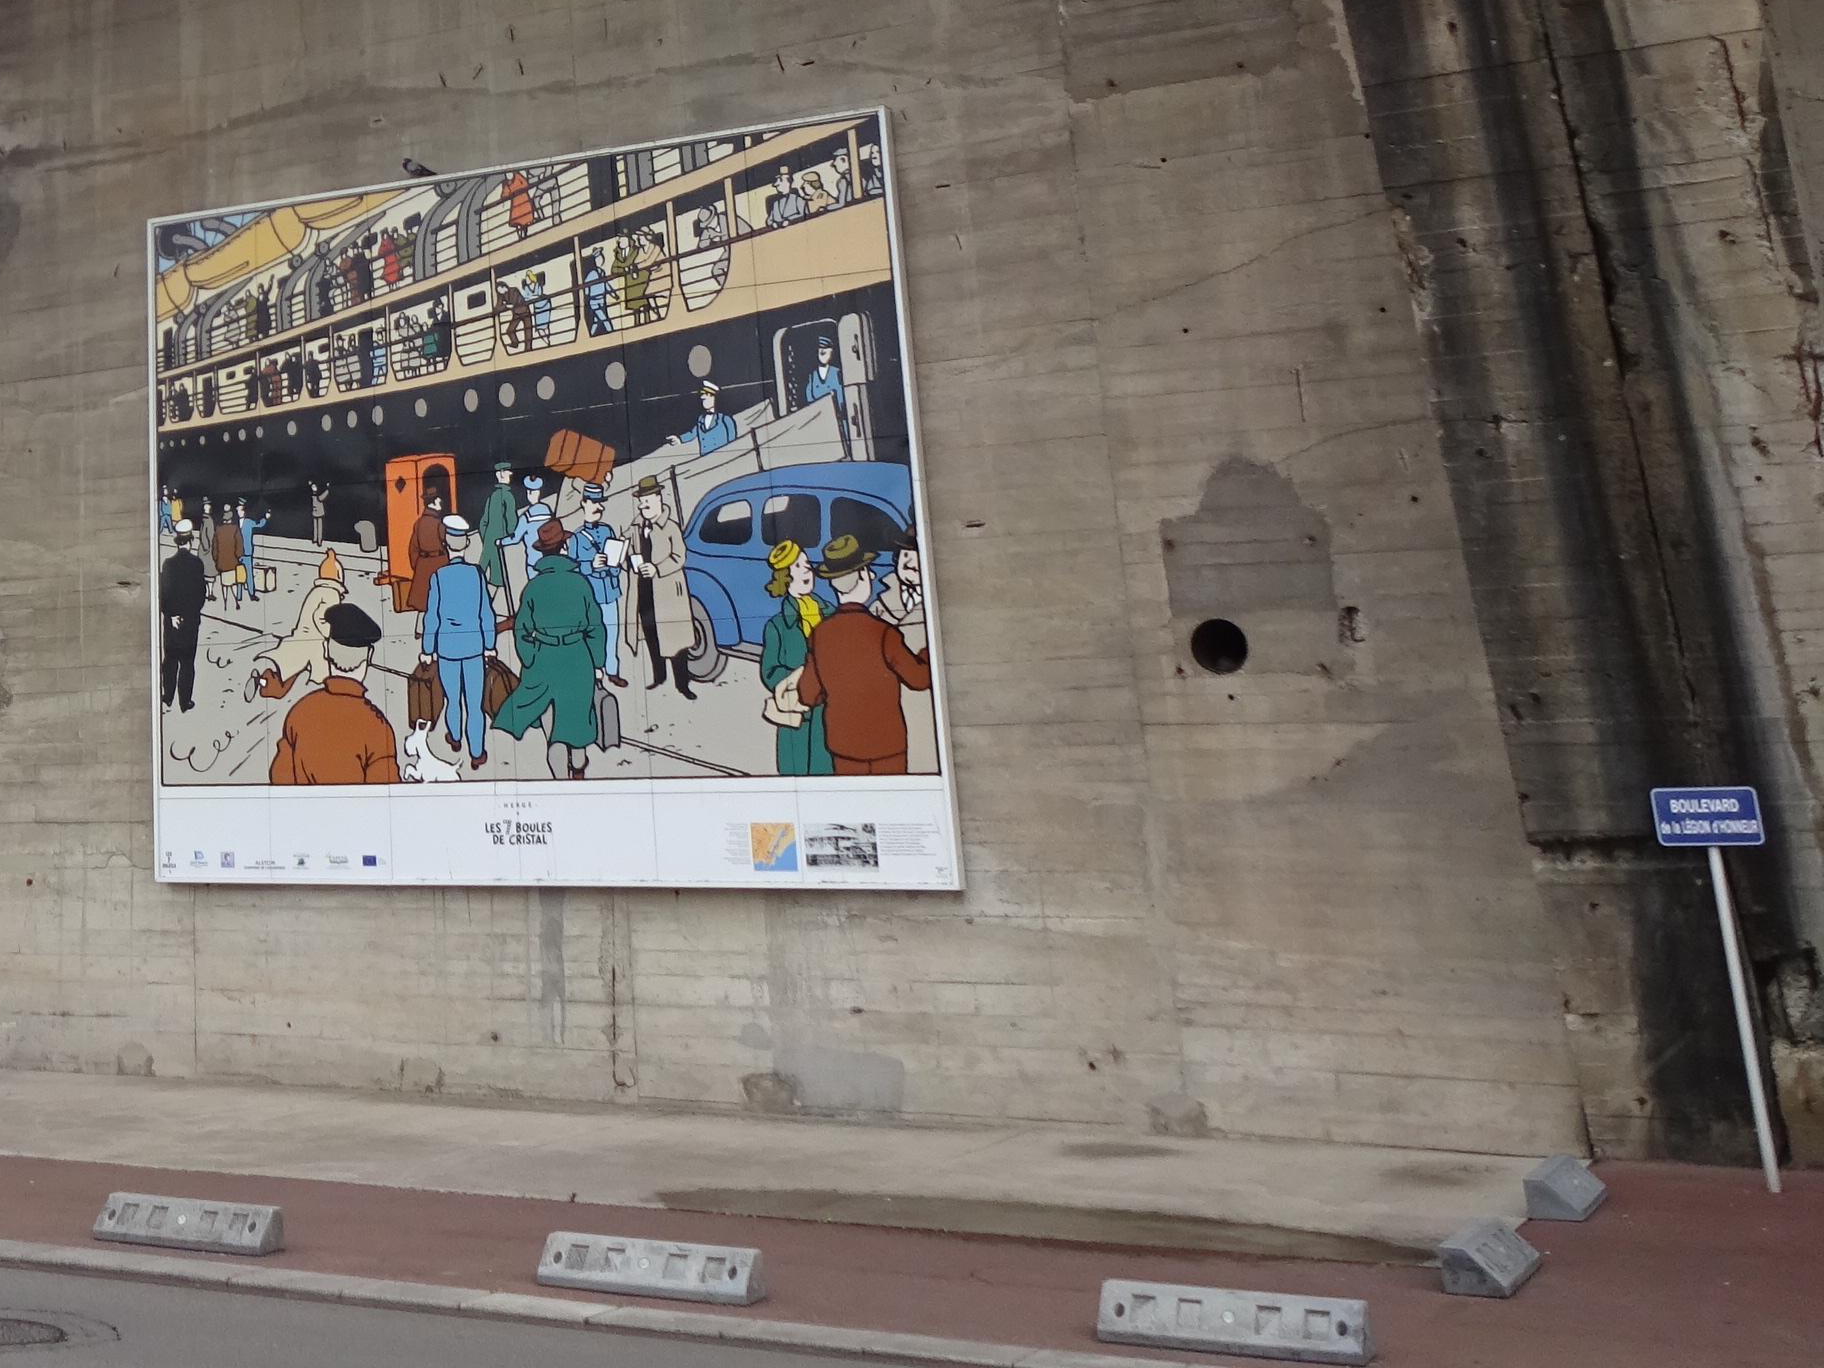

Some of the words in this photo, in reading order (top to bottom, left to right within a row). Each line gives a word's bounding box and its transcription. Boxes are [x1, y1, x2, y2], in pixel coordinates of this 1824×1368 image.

[1670, 799, 1739, 813] BOULEVARD
[485, 822, 501, 833] LES
[503, 819, 512, 835] 7
[516, 821, 552, 833] BOULES
[493, 834, 504, 845] DE
[509, 834, 547, 845] CRISTAL
